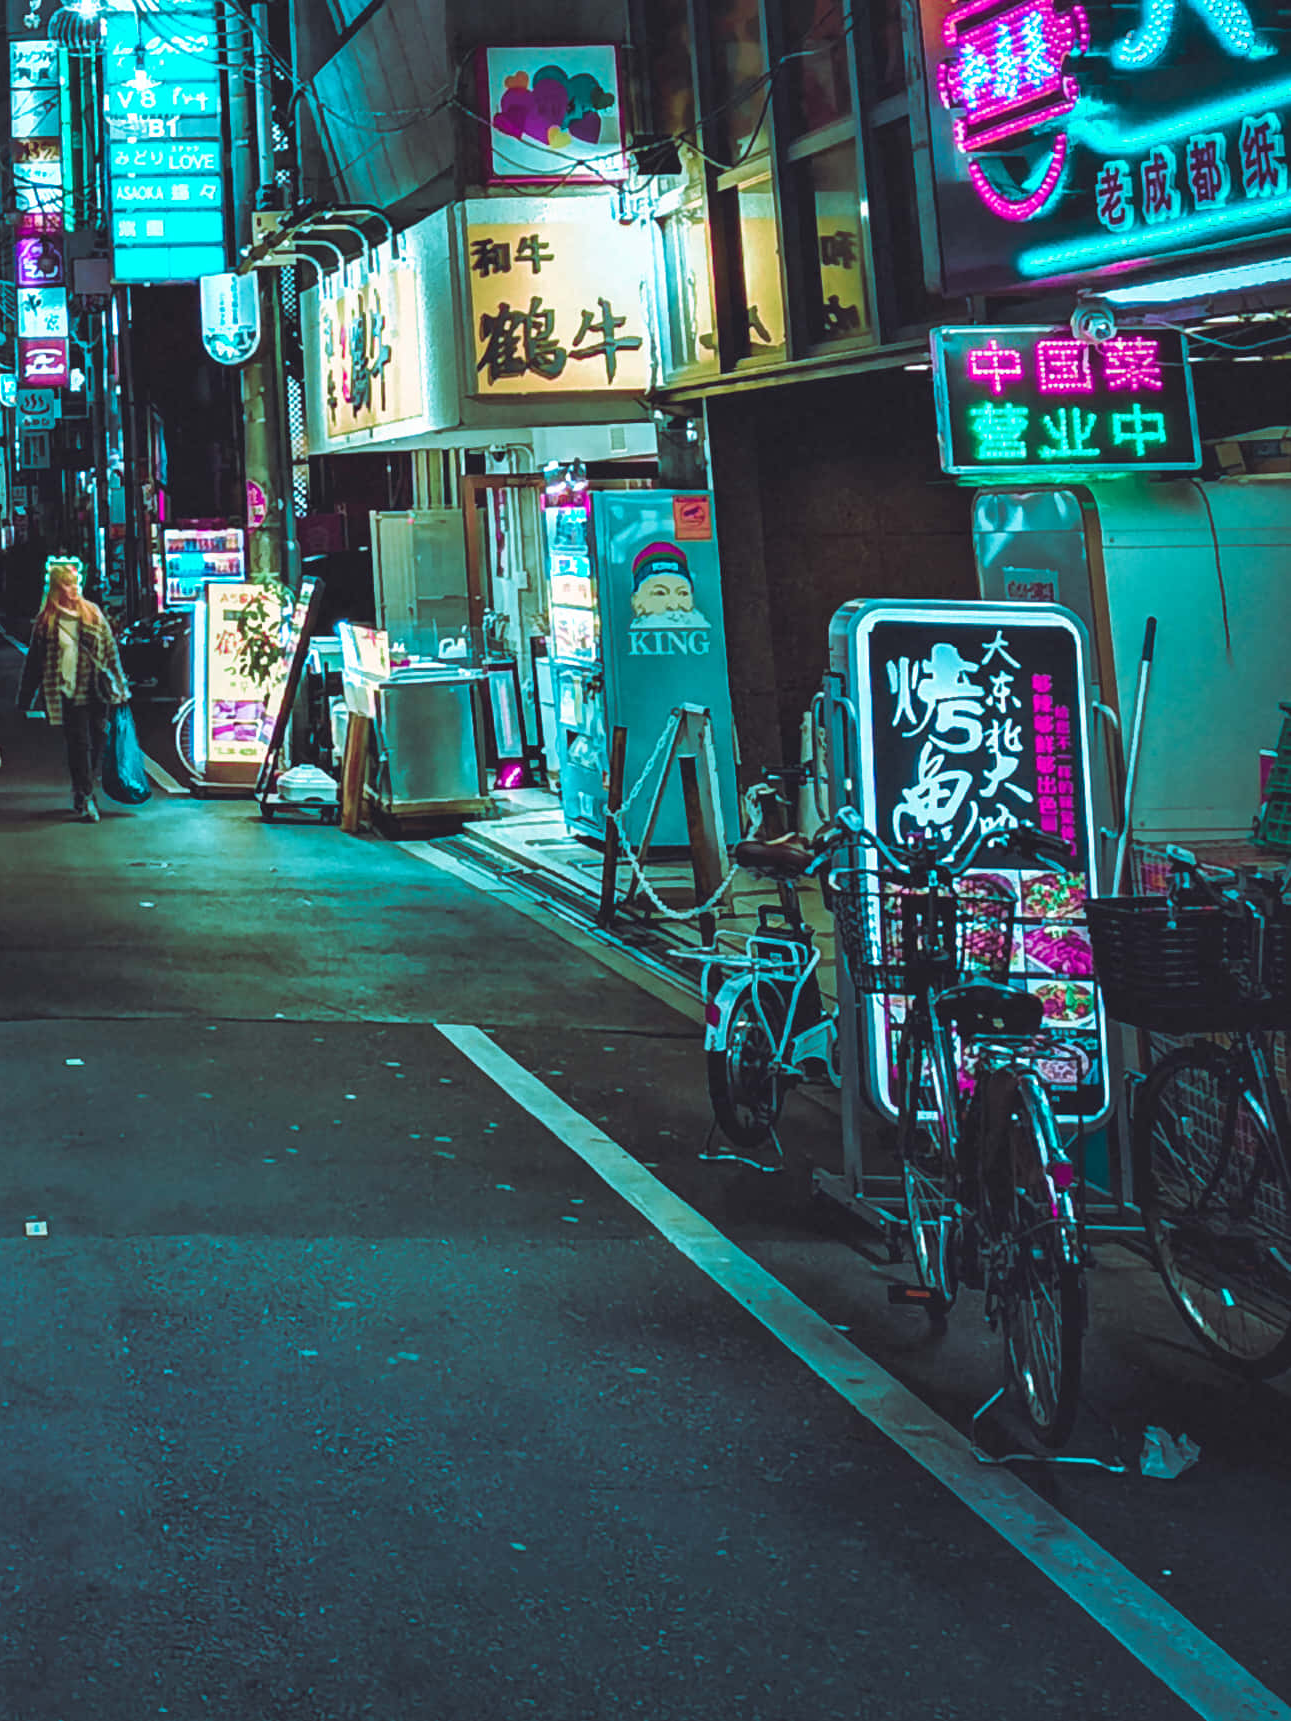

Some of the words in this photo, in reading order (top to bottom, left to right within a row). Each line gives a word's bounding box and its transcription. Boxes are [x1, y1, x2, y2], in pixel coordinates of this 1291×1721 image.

[148, 116, 179, 138] B1
[114, 149, 164, 166] みどり
[169, 153, 215, 170] LOVE
[1094, 112, 1288, 233] 老成都纸
[470, 234, 555, 277] 和牛
[627, 630, 711, 656] KING
